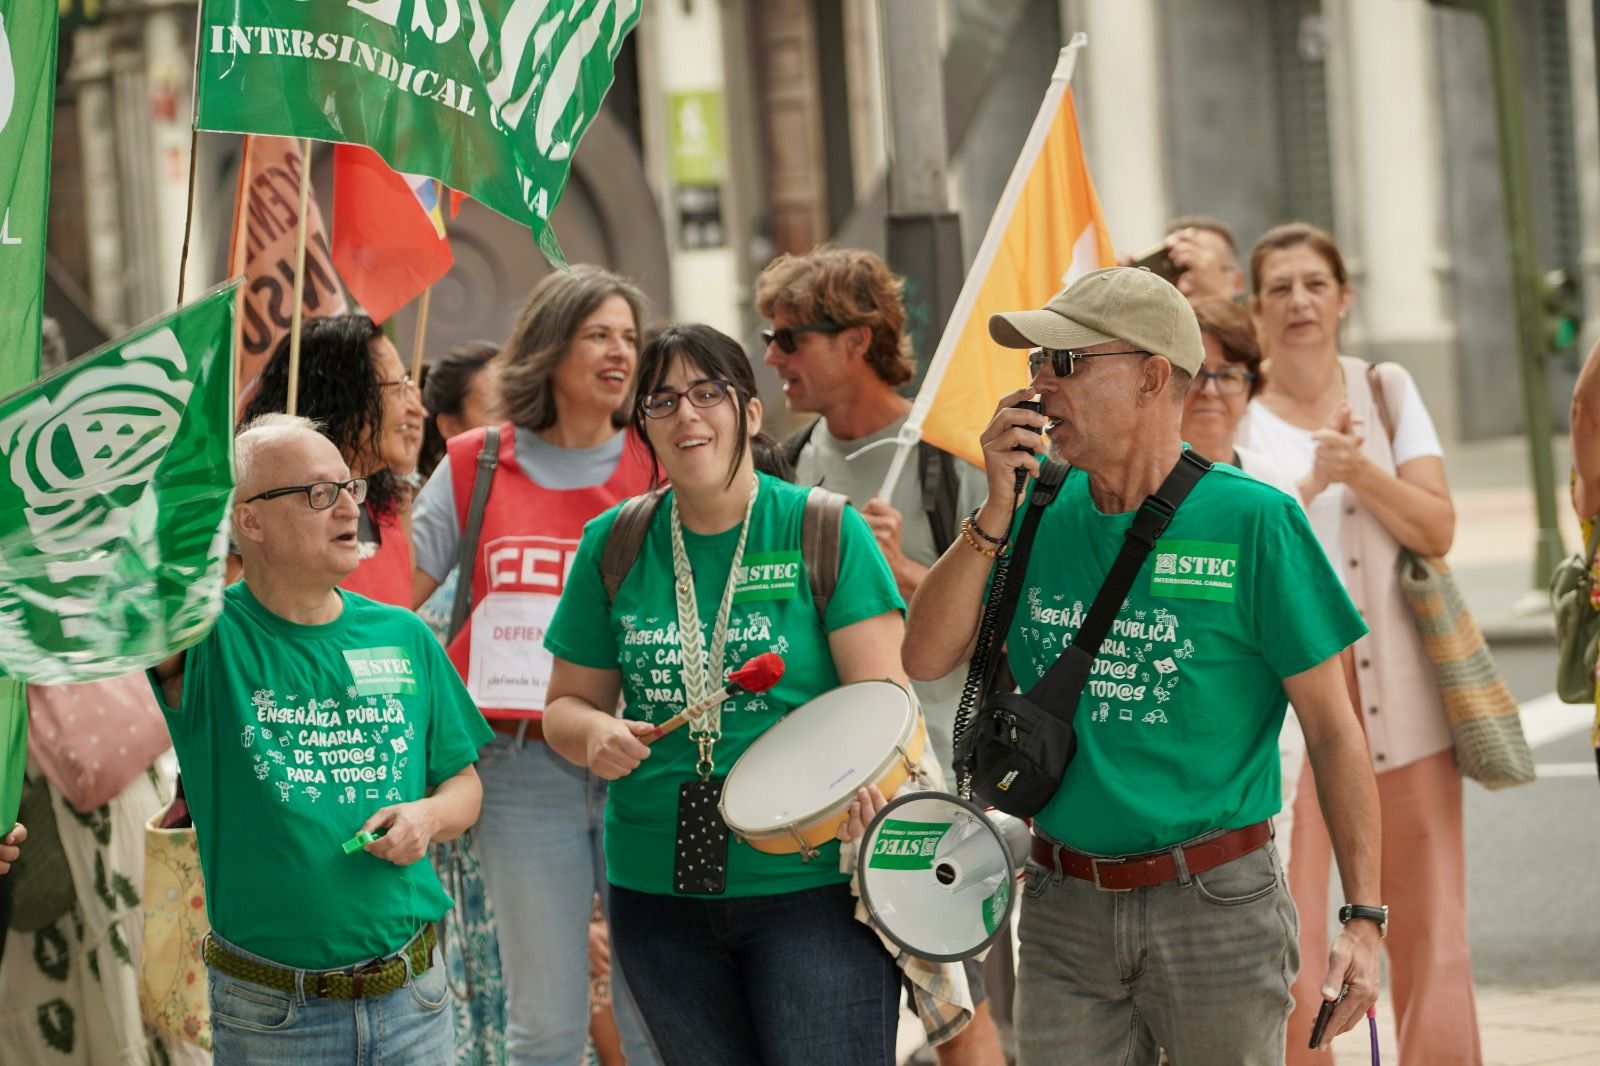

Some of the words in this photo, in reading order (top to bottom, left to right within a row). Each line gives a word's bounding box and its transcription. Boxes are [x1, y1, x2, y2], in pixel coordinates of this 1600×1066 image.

[210, 25, 476, 117] INTERSINDICAL
[749, 563, 798, 581] STEC
[1178, 555, 1236, 577] STEC
[492, 626, 544, 640] DEFIEN
[727, 625, 770, 642] BLICA
[1113, 618, 1176, 642] PÚBLICA
[368, 657, 413, 674] STEC
[650, 669, 673, 684] DE
[645, 688, 684, 703] PARA
[1089, 681, 1146, 701] TOD@S
[345, 705, 406, 724] PÚBLICA
[299, 728, 368, 747] CANARIA:
[293, 749, 315, 765] DE
[319, 747, 375, 766] TOD@S
[286, 766, 326, 784] PARA
[331, 765, 387, 783] TOD@S
[873, 838, 922, 855] STEC
